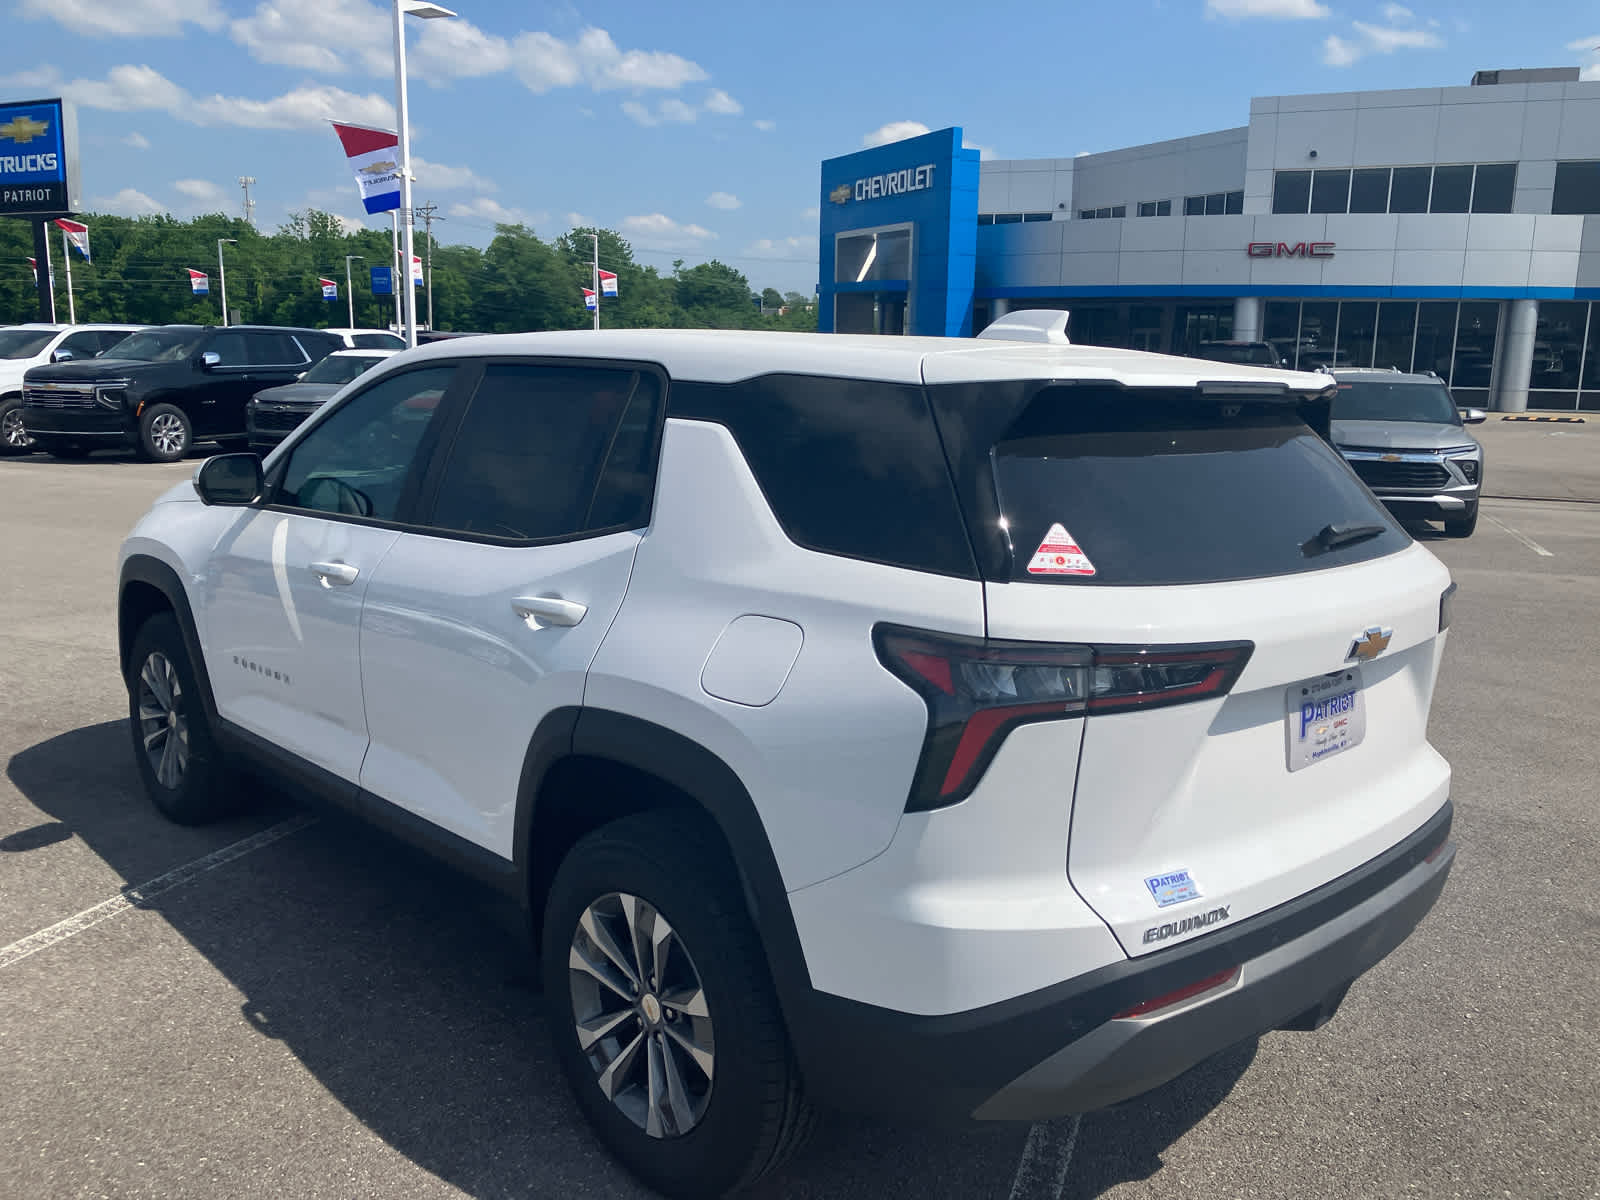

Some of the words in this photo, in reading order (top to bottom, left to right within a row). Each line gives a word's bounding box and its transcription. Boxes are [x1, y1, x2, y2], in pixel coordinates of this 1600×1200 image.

[0, 153, 57, 173] TRUCKS
[855, 164, 936, 201] CHEVROLET
[4, 189, 51, 202] PATRIOT
[1248, 242, 1335, 258] GMC
[1301, 690, 1356, 739] PATRIOT
[1150, 871, 1190, 894] PATRIOT
[1142, 904, 1231, 944] EQUINOX
